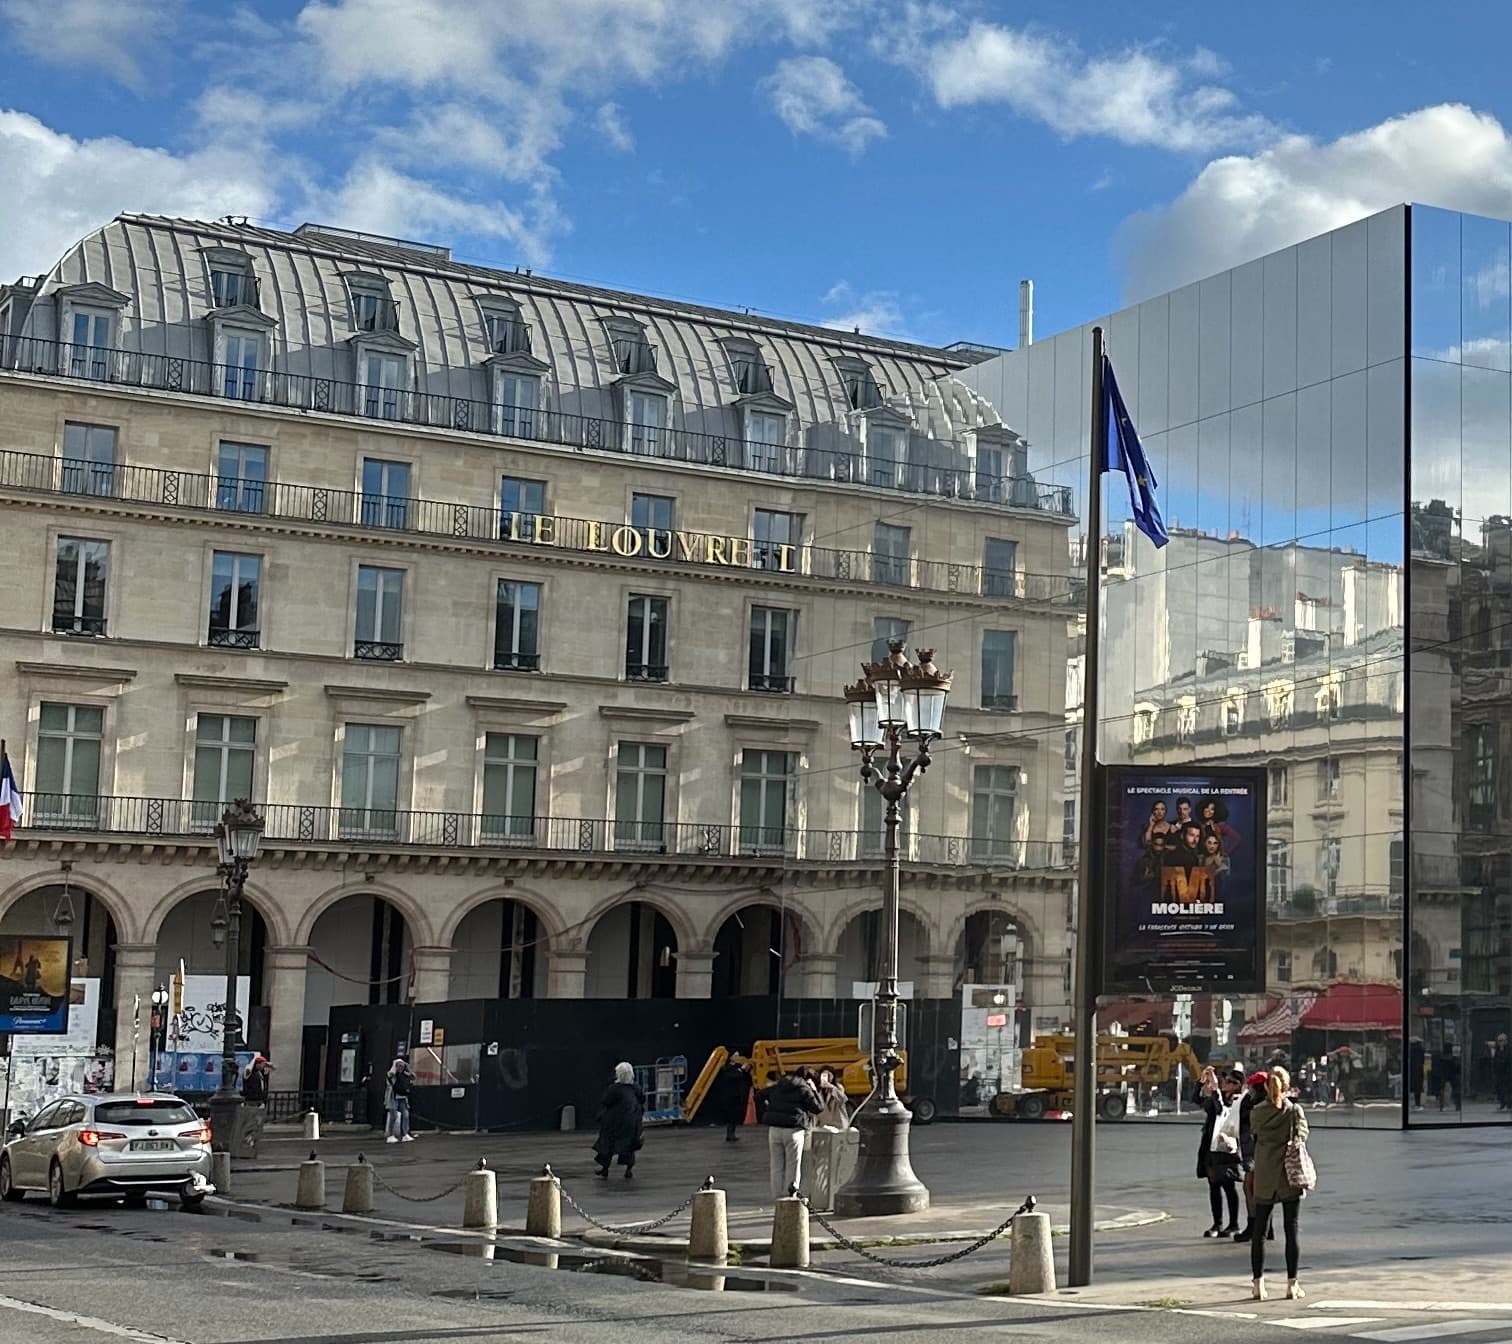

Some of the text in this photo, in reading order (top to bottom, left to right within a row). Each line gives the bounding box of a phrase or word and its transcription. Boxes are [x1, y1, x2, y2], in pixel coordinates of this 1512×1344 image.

[510, 511, 556, 545] LE
[586, 520, 751, 568] LOUVRE
[1151, 899, 1225, 915] MOLIÈRE
